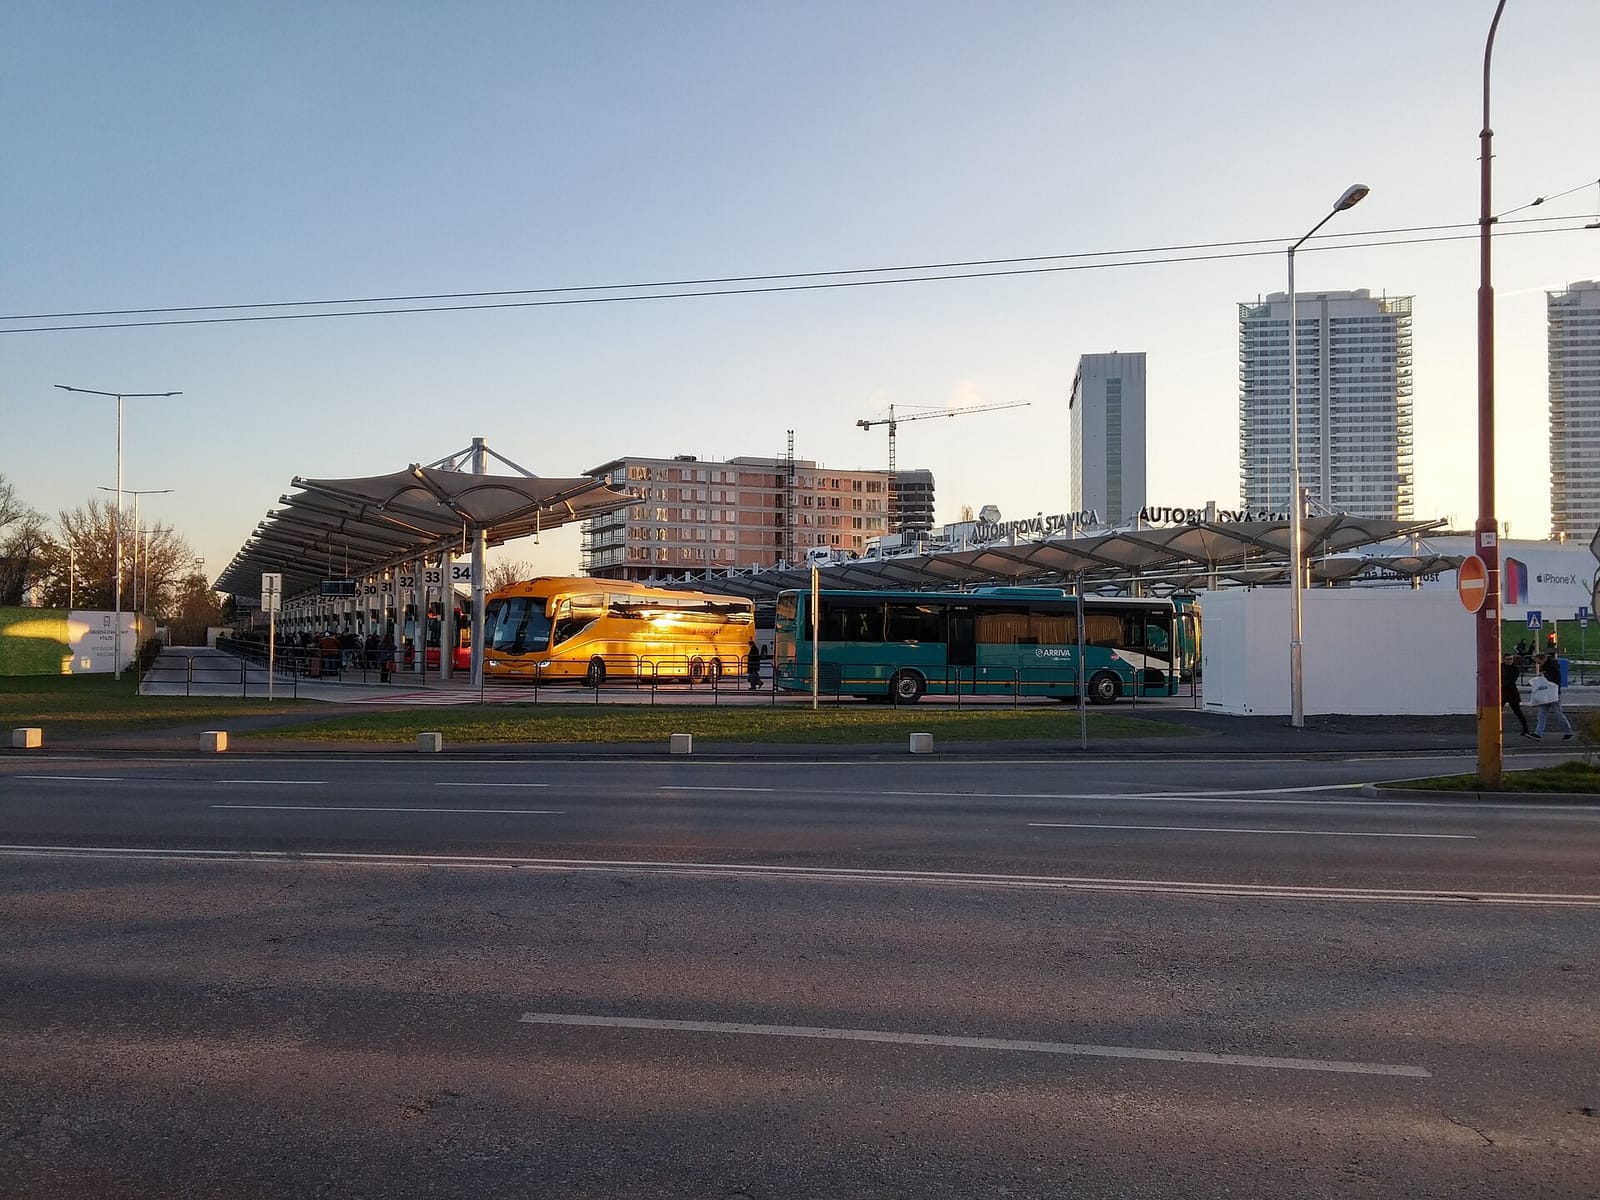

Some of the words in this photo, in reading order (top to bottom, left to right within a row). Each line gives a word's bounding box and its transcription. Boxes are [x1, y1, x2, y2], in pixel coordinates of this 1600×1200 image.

[1139, 505, 1252, 523] AUTOBUOVÁ
[972, 512, 1043, 544] AUTOBUSOVÁ
[1045, 509, 1099, 532] STANICA
[425, 571, 440, 583] 33
[452, 566, 471, 580] 34
[1543, 573, 1569, 584] iPhone
[1570, 574, 1576, 584] X
[381, 582, 392, 592] 31
[400, 576, 414, 588] 32
[364, 585, 377, 595] 30
[1043, 649, 1071, 657] ARRIVA
